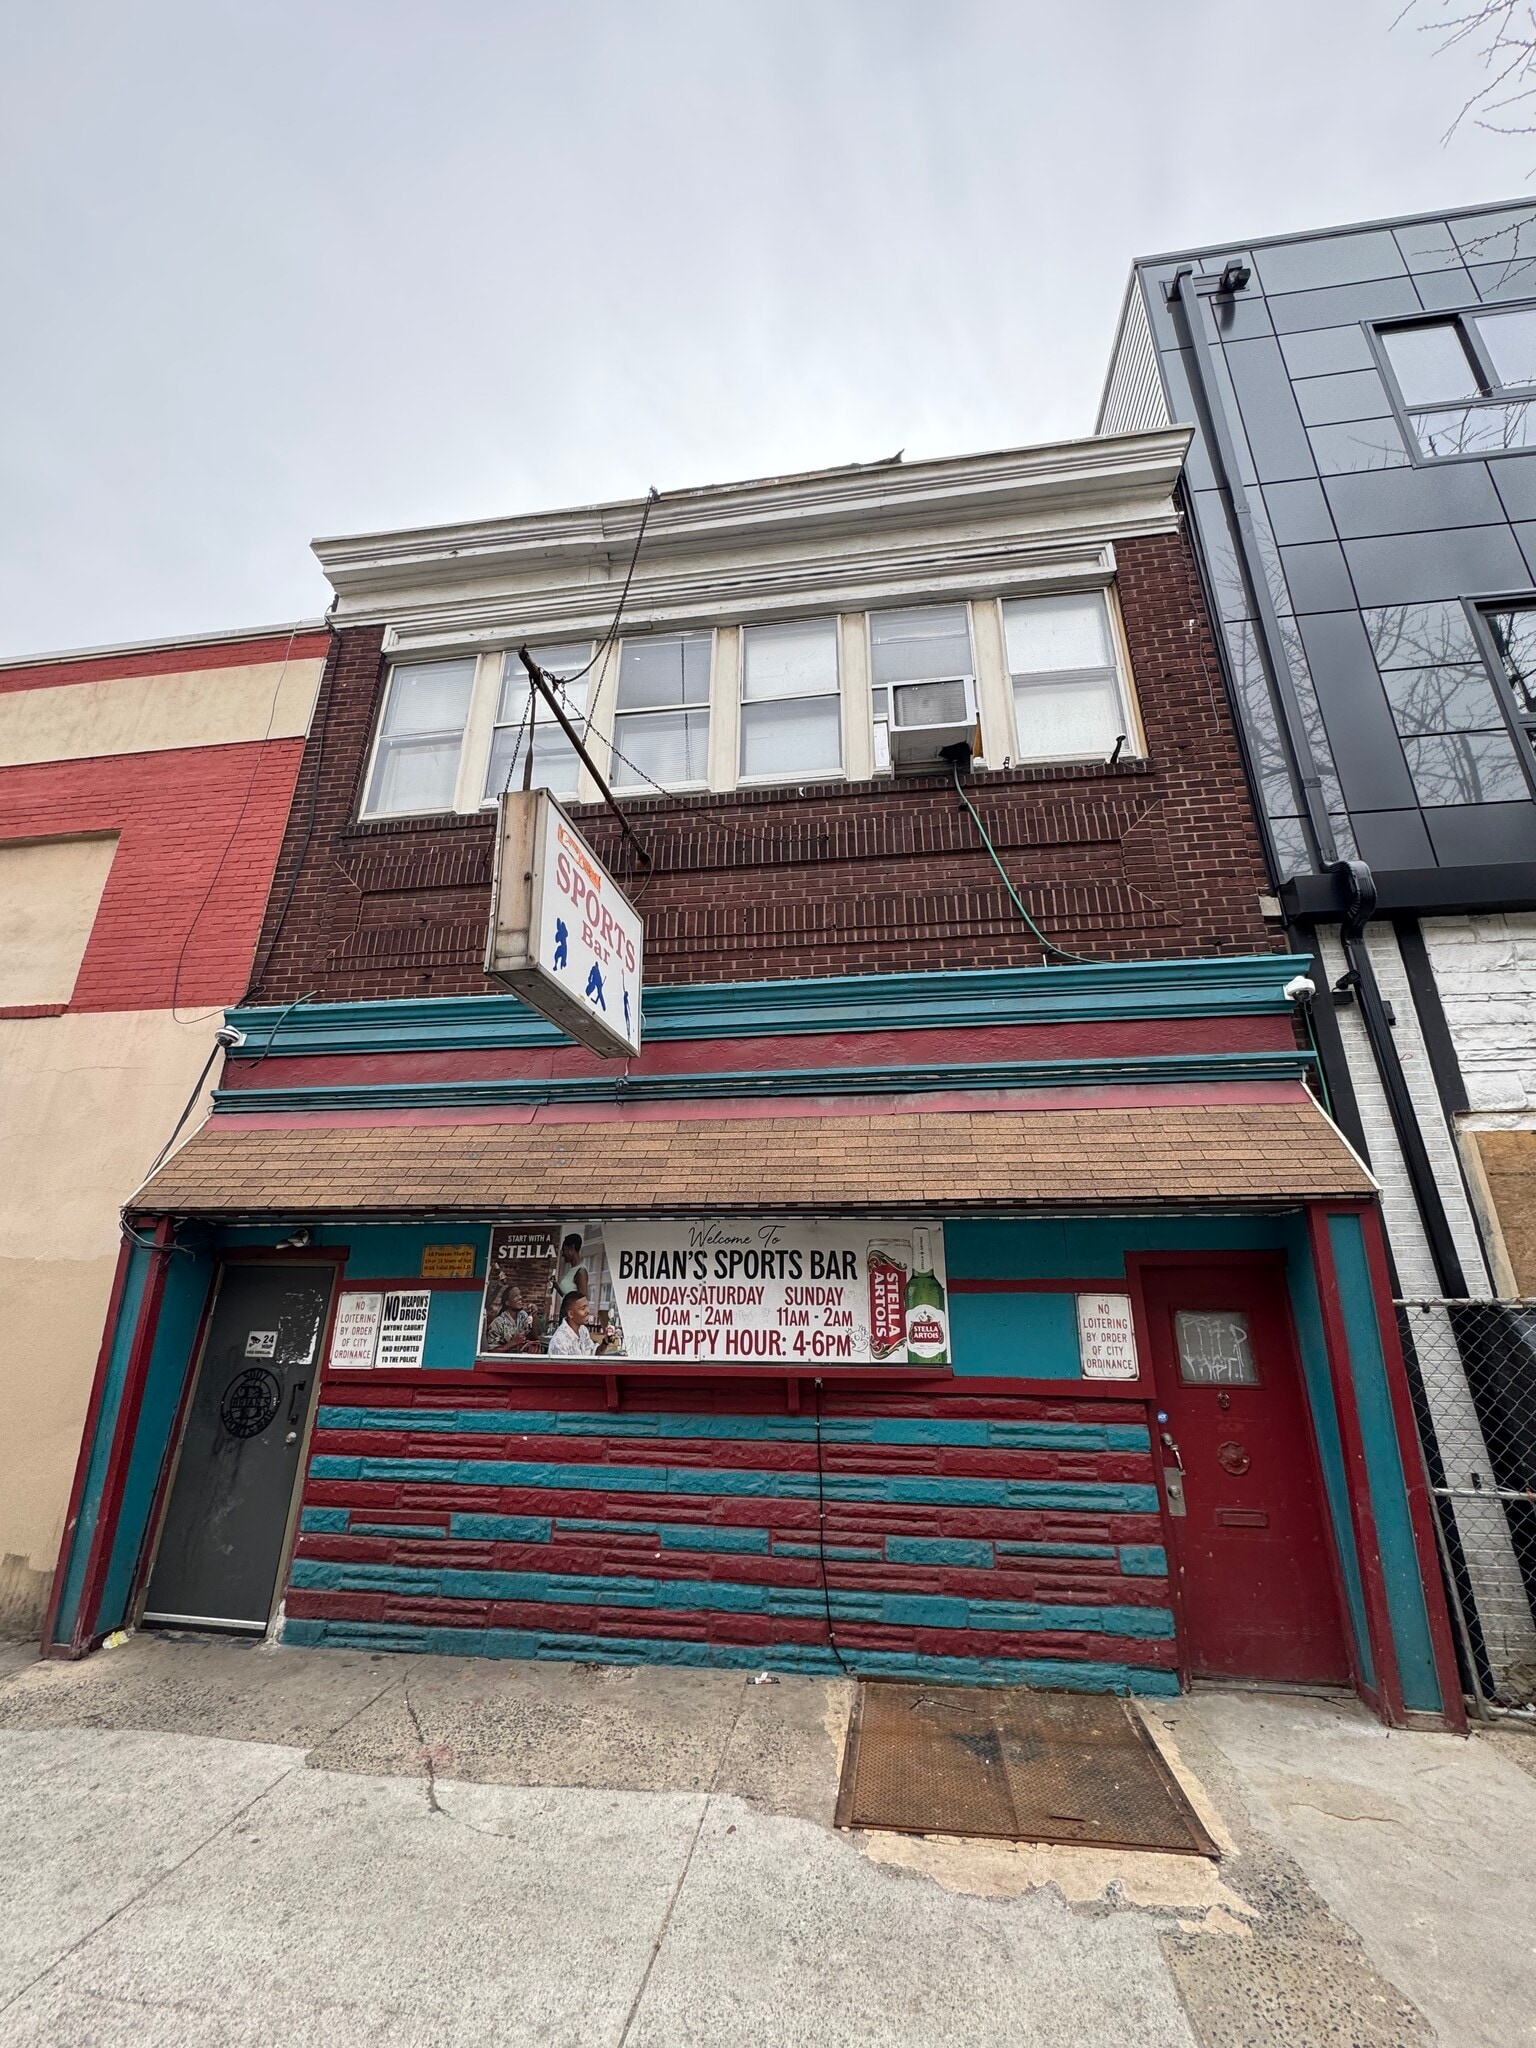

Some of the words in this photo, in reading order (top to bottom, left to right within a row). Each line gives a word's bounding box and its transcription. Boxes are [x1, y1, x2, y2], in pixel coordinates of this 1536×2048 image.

[556, 852, 635, 973] SPORTS
[582, 920, 610, 966] Bar
[688, 1224, 752, 1247] Welcome
[758, 1225, 786, 1248] To
[498, 1244, 557, 1259] STELLA
[619, 1250, 708, 1279] BRIAN'S
[714, 1250, 802, 1280] SPORTS
[810, 1250, 858, 1280] BAR
[626, 1286, 764, 1305] MONDAY-SATURDAY
[785, 1286, 844, 1306] SUNDAY
[355, 1301, 365, 1310] NO
[384, 1296, 400, 1321] NO
[401, 1296, 428, 1307] WEAPON'S
[874, 1272, 887, 1337] ARTOIS
[887, 1272, 900, 1337] STELLA
[1098, 1304, 1110, 1314] NO
[340, 1314, 376, 1323] LOITERING
[400, 1309, 427, 1320] DRUGS
[656, 1306, 690, 1326] 10AM
[705, 1306, 733, 1325] 2AM
[776, 1307, 809, 1326] 11AM
[824, 1308, 853, 1326] 2AM
[340, 1327, 349, 1335] BY
[352, 1327, 372, 1335] ORDER
[1083, 1318, 1128, 1329] LOITERING
[263, 1335, 274, 1343] 24
[353, 1338, 367, 1347] CITY
[654, 1330, 719, 1356] HAPPY
[726, 1330, 786, 1356] HOUR:
[793, 1330, 851, 1356] 4-6PM
[1086, 1333, 1096, 1341] BY
[1101, 1333, 1127, 1343] ORDER
[334, 1350, 371, 1359] ORDINANCE
[1092, 1346, 1102, 1356] OF
[1107, 1346, 1124, 1356] CITY
[1086, 1359, 1133, 1370] ORDINANCE
